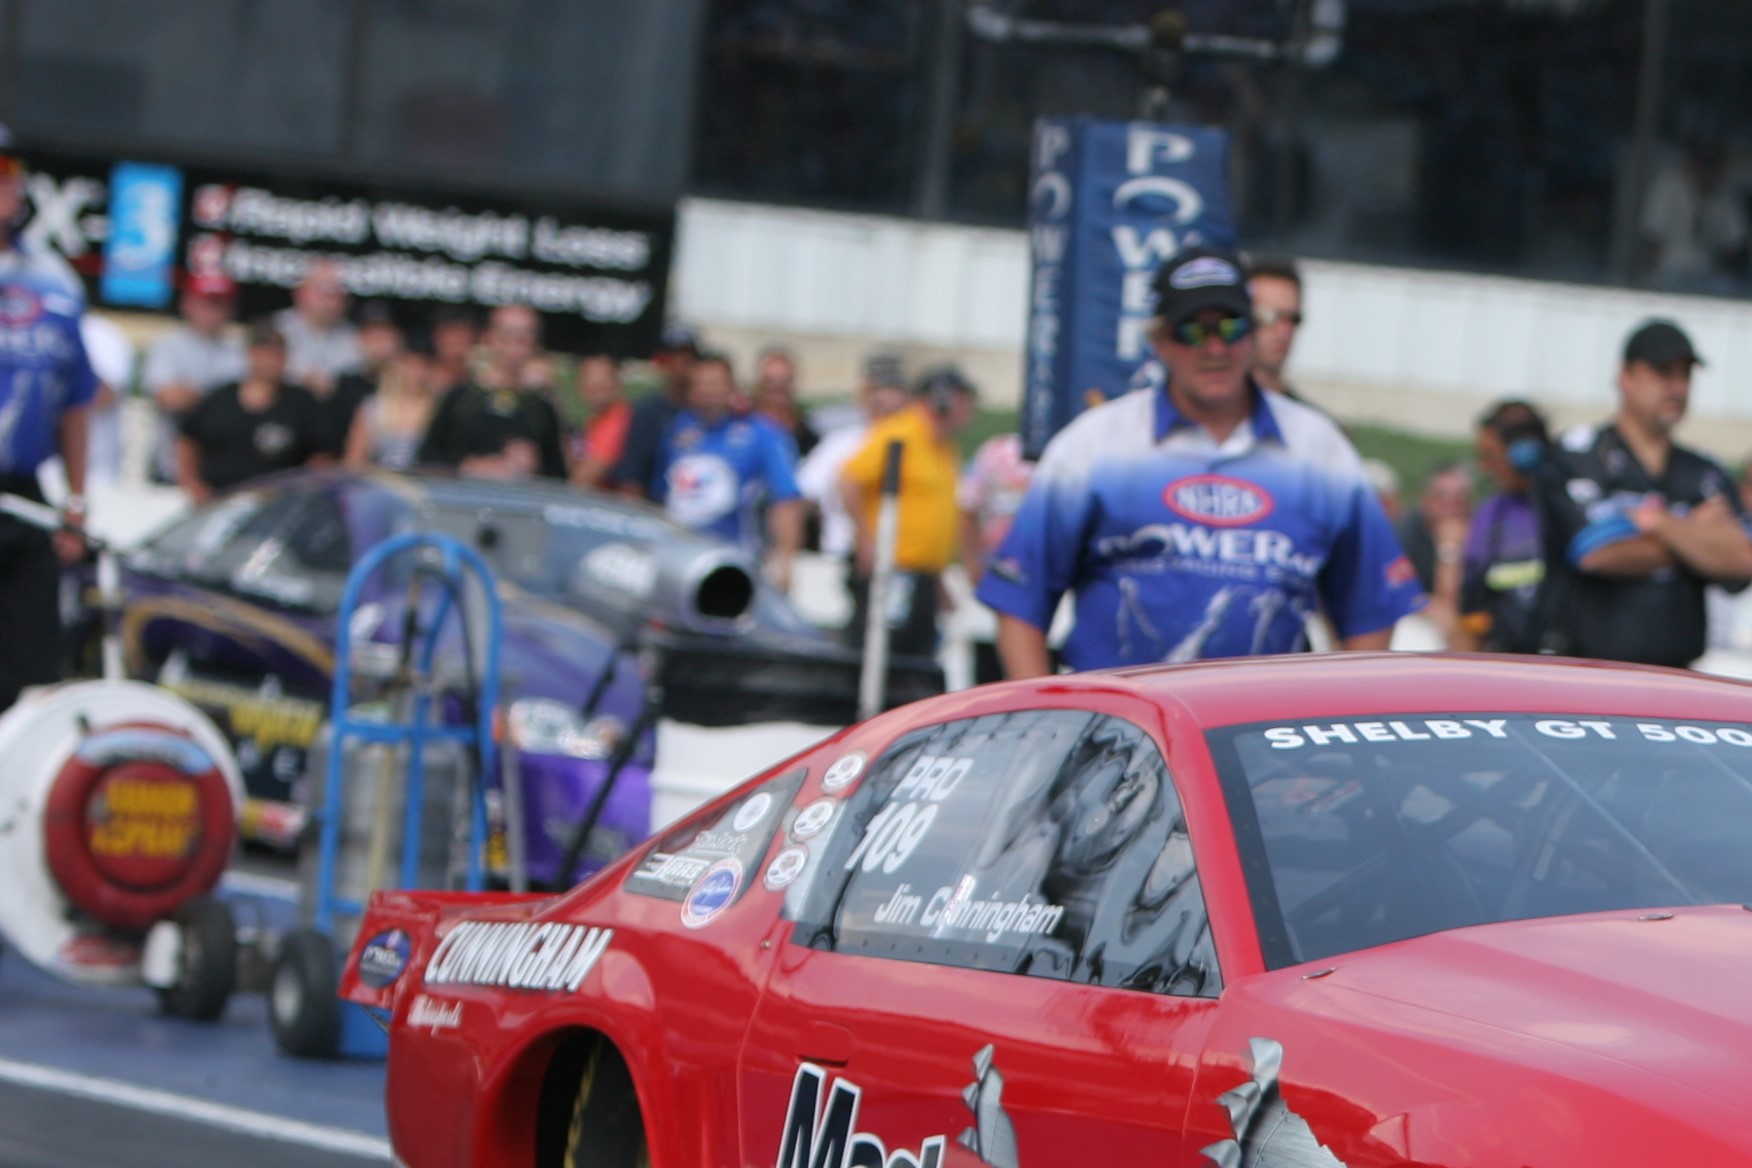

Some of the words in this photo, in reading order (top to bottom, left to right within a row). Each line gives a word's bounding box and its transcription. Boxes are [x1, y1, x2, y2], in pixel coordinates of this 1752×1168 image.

[1264, 719, 1508, 750] SHELBY
[1535, 719, 1619, 741] GT
[891, 755, 974, 801] PRO
[844, 801, 939, 875] 109
[873, 884, 922, 925] Jim
[424, 920, 615, 993] CUNNINGHAM
